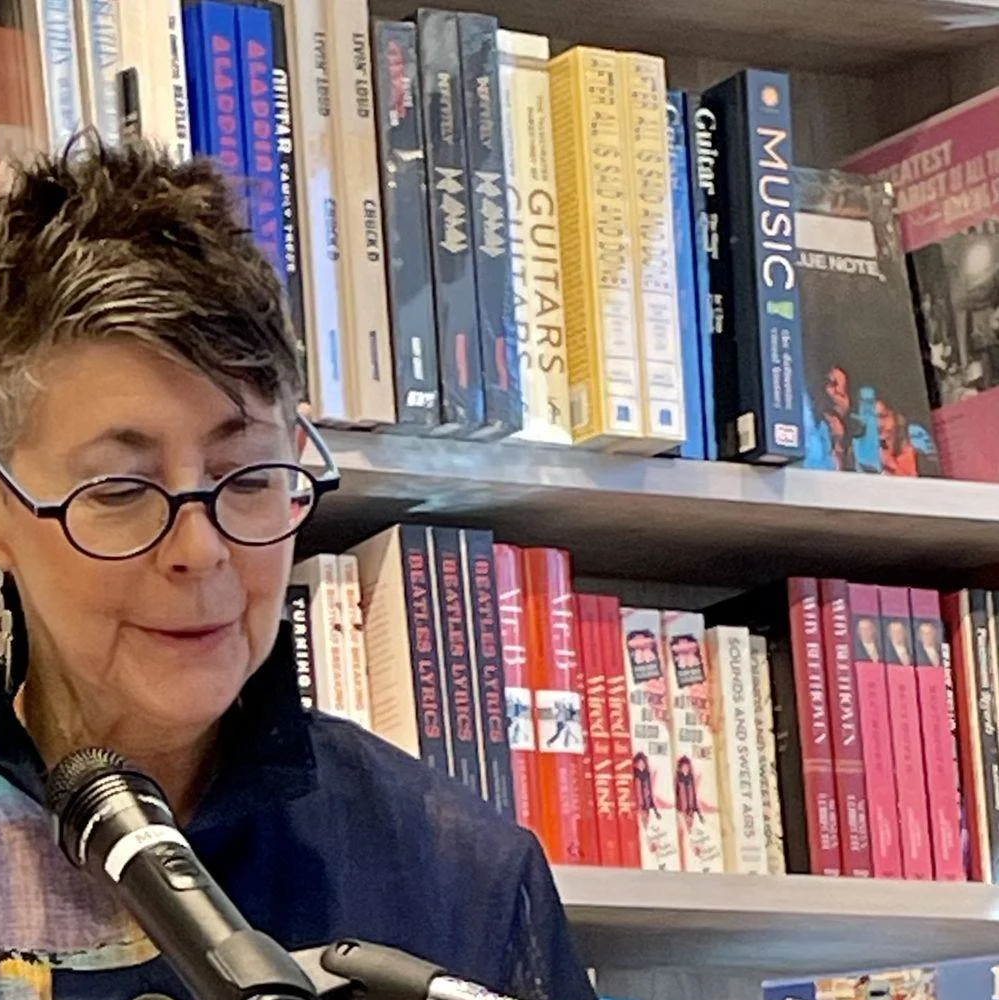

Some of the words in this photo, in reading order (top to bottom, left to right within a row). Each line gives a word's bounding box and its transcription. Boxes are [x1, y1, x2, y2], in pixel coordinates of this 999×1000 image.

[172, 84, 187, 140] BEATLES
[247, 40, 274, 173] ALADDIN
[272, 69, 291, 154] GUITAR
[317, 77, 330, 118] LOUD
[356, 79, 370, 118] LOUD
[695, 108, 719, 196] Guitar
[363, 199, 379, 248] CHUCK
[757, 126, 794, 291] MUSIC
[367, 250, 379, 262] D
[527, 188, 565, 376] GUITARS
[828, 255, 880, 278] NOTE
[407, 548, 431, 652] BEATLES
[442, 553, 467, 656] BEATLES
[475, 556, 499, 657] BEATLES
[292, 597, 311, 688] TURNING
[728, 636, 746, 702] SOUNDS
[418, 659, 441, 739] LYRICS
[451, 663, 474, 741] LYRICS
[484, 664, 503, 743] LYRICS
[586, 674, 610, 738] Wired
[605, 674, 629, 738] Wired
[734, 707, 747, 742] AND
[806, 642, 829, 744] BEETHOVEN
[836, 644, 857, 746] BEETHOVEN
[736, 744, 753, 800] SWEET
[742, 803, 756, 839] AIRS
